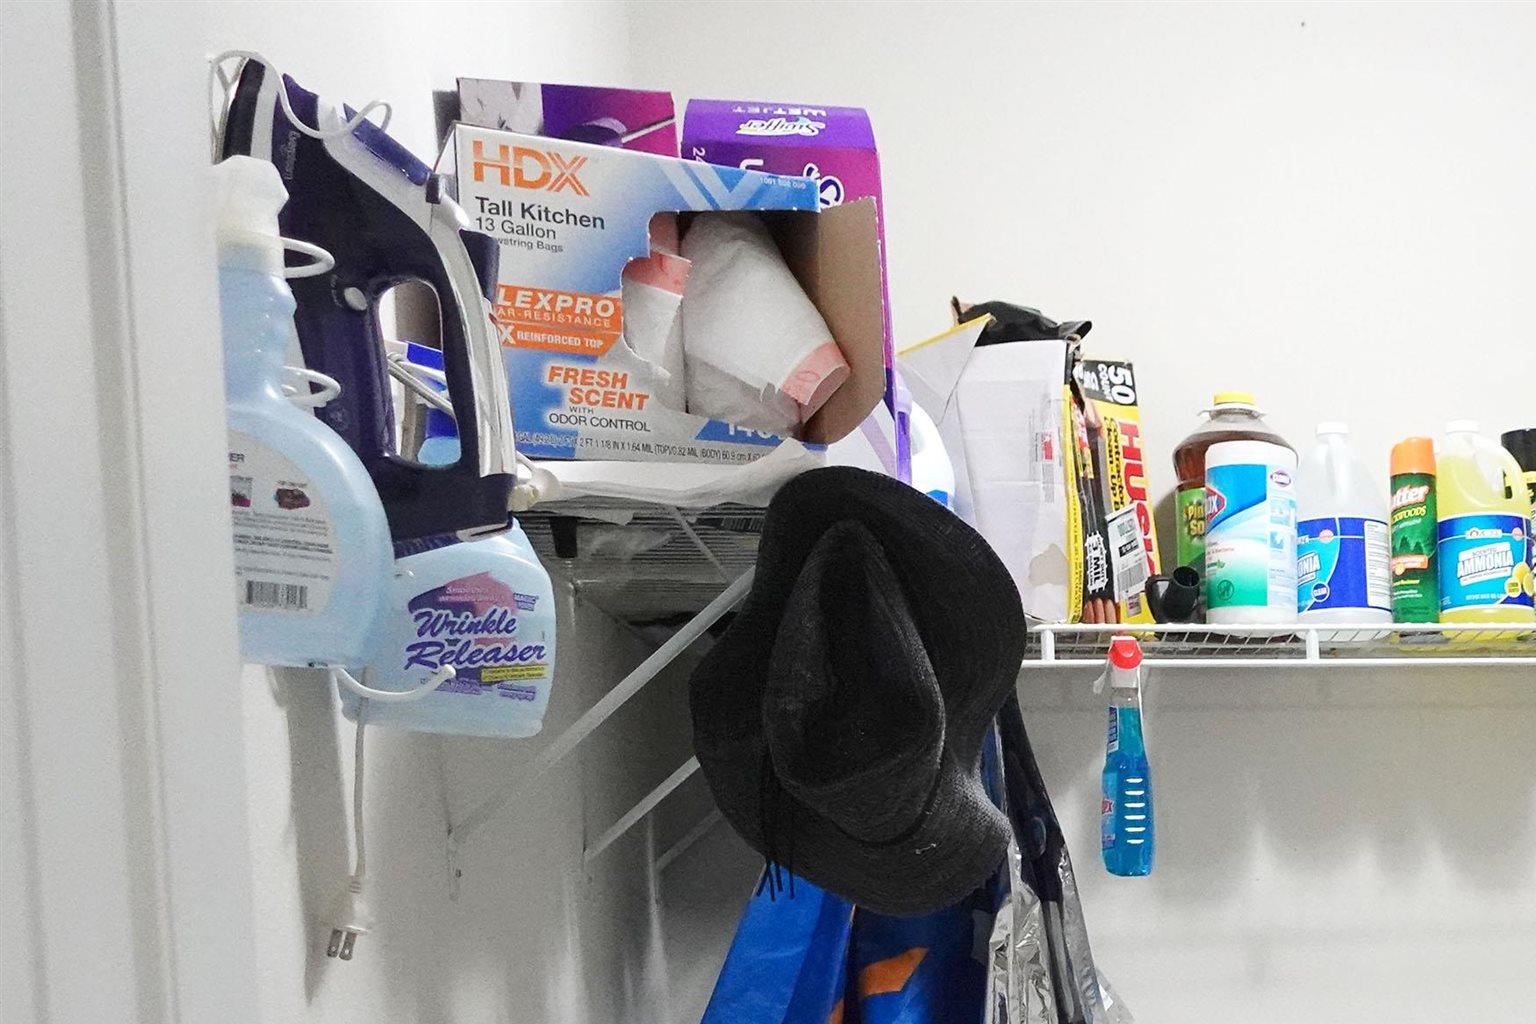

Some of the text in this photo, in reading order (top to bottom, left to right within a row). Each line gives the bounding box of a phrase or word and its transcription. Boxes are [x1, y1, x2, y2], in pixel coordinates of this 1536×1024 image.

[736, 117, 826, 136] Swiffer
[473, 139, 590, 197] HDX
[475, 196, 605, 230] Tall Kitchen
[475, 217, 557, 240] 13 Gallon
[497, 238, 564, 253] wstring Bags
[497, 287, 616, 318] LEXPRO
[497, 308, 612, 328] AR-RESISTANCE
[498, 323, 604, 349] X REINFORCED TOP
[547, 365, 629, 390] FRESH
[1107, 365, 1136, 405] 50
[568, 388, 650, 411] SCENT
[569, 406, 594, 415] WITH
[548, 413, 652, 433] ODOR CONTROL
[1093, 556, 1101, 584] MIL
[1457, 549, 1514, 579] AMMONIA
[413, 607, 517, 638] Wrinkle
[404, 639, 547, 671] Releaser
